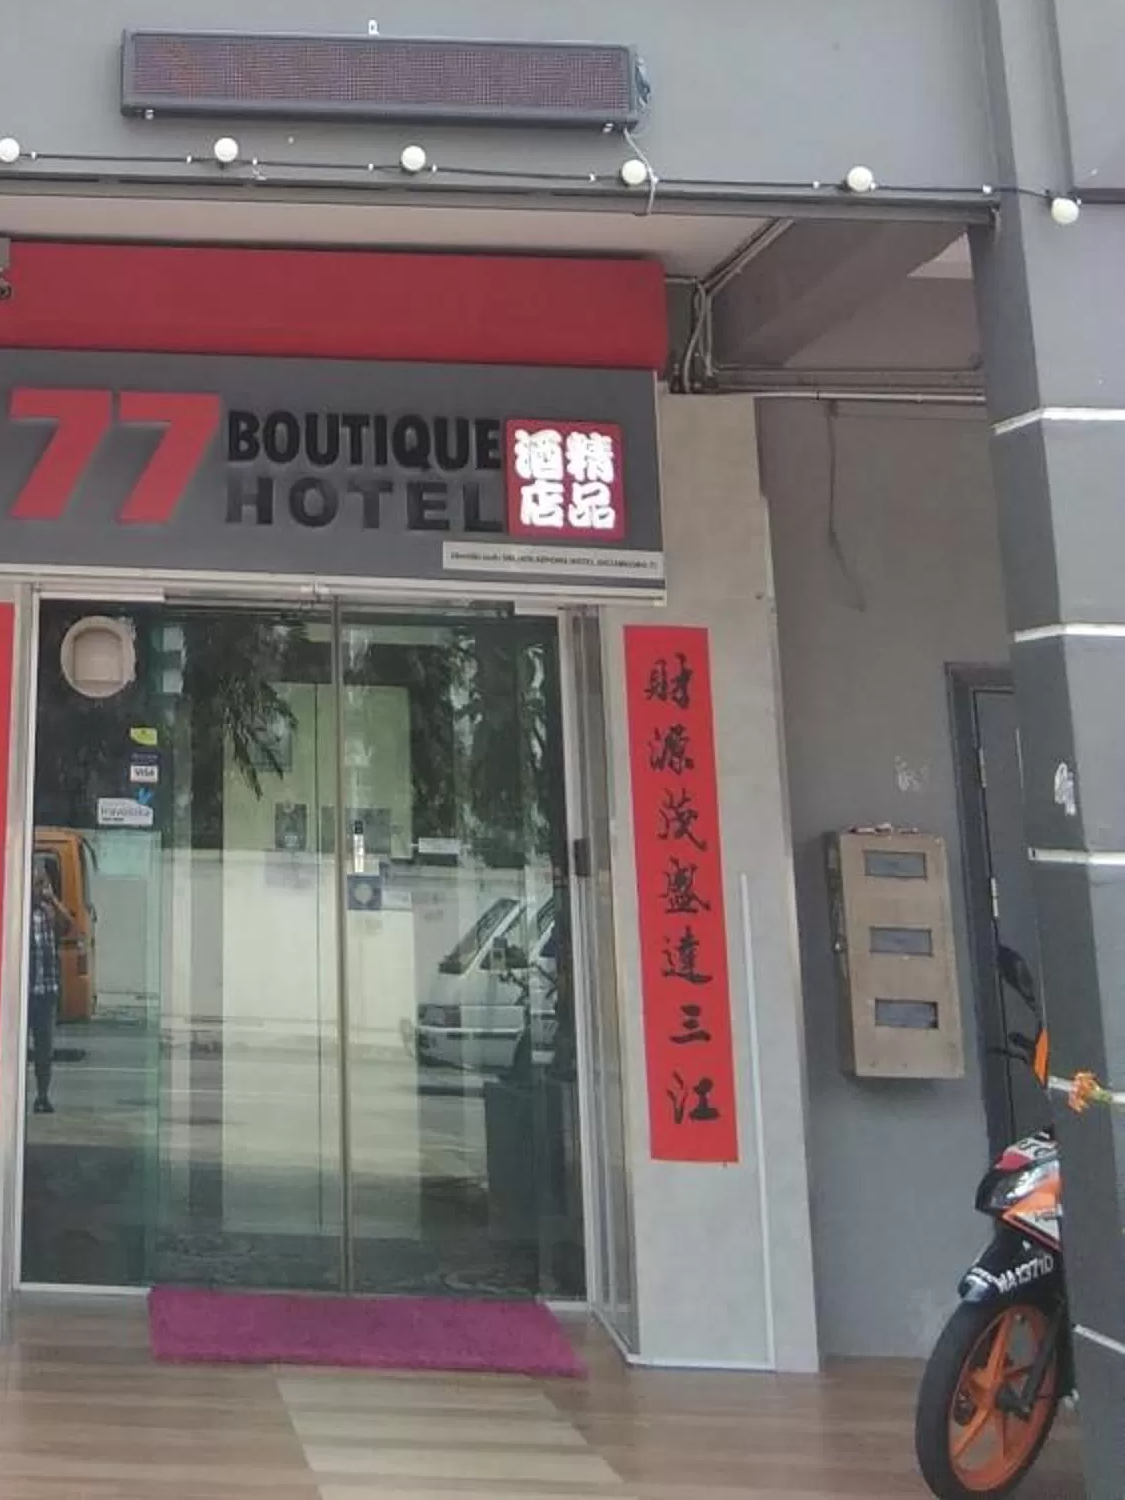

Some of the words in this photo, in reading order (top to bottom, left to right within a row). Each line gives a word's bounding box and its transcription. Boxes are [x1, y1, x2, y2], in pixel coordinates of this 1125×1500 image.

[9, 387, 221, 525] 77
[227, 410, 501, 472] BOUTIQUE
[225, 475, 503, 533] HOTEL
